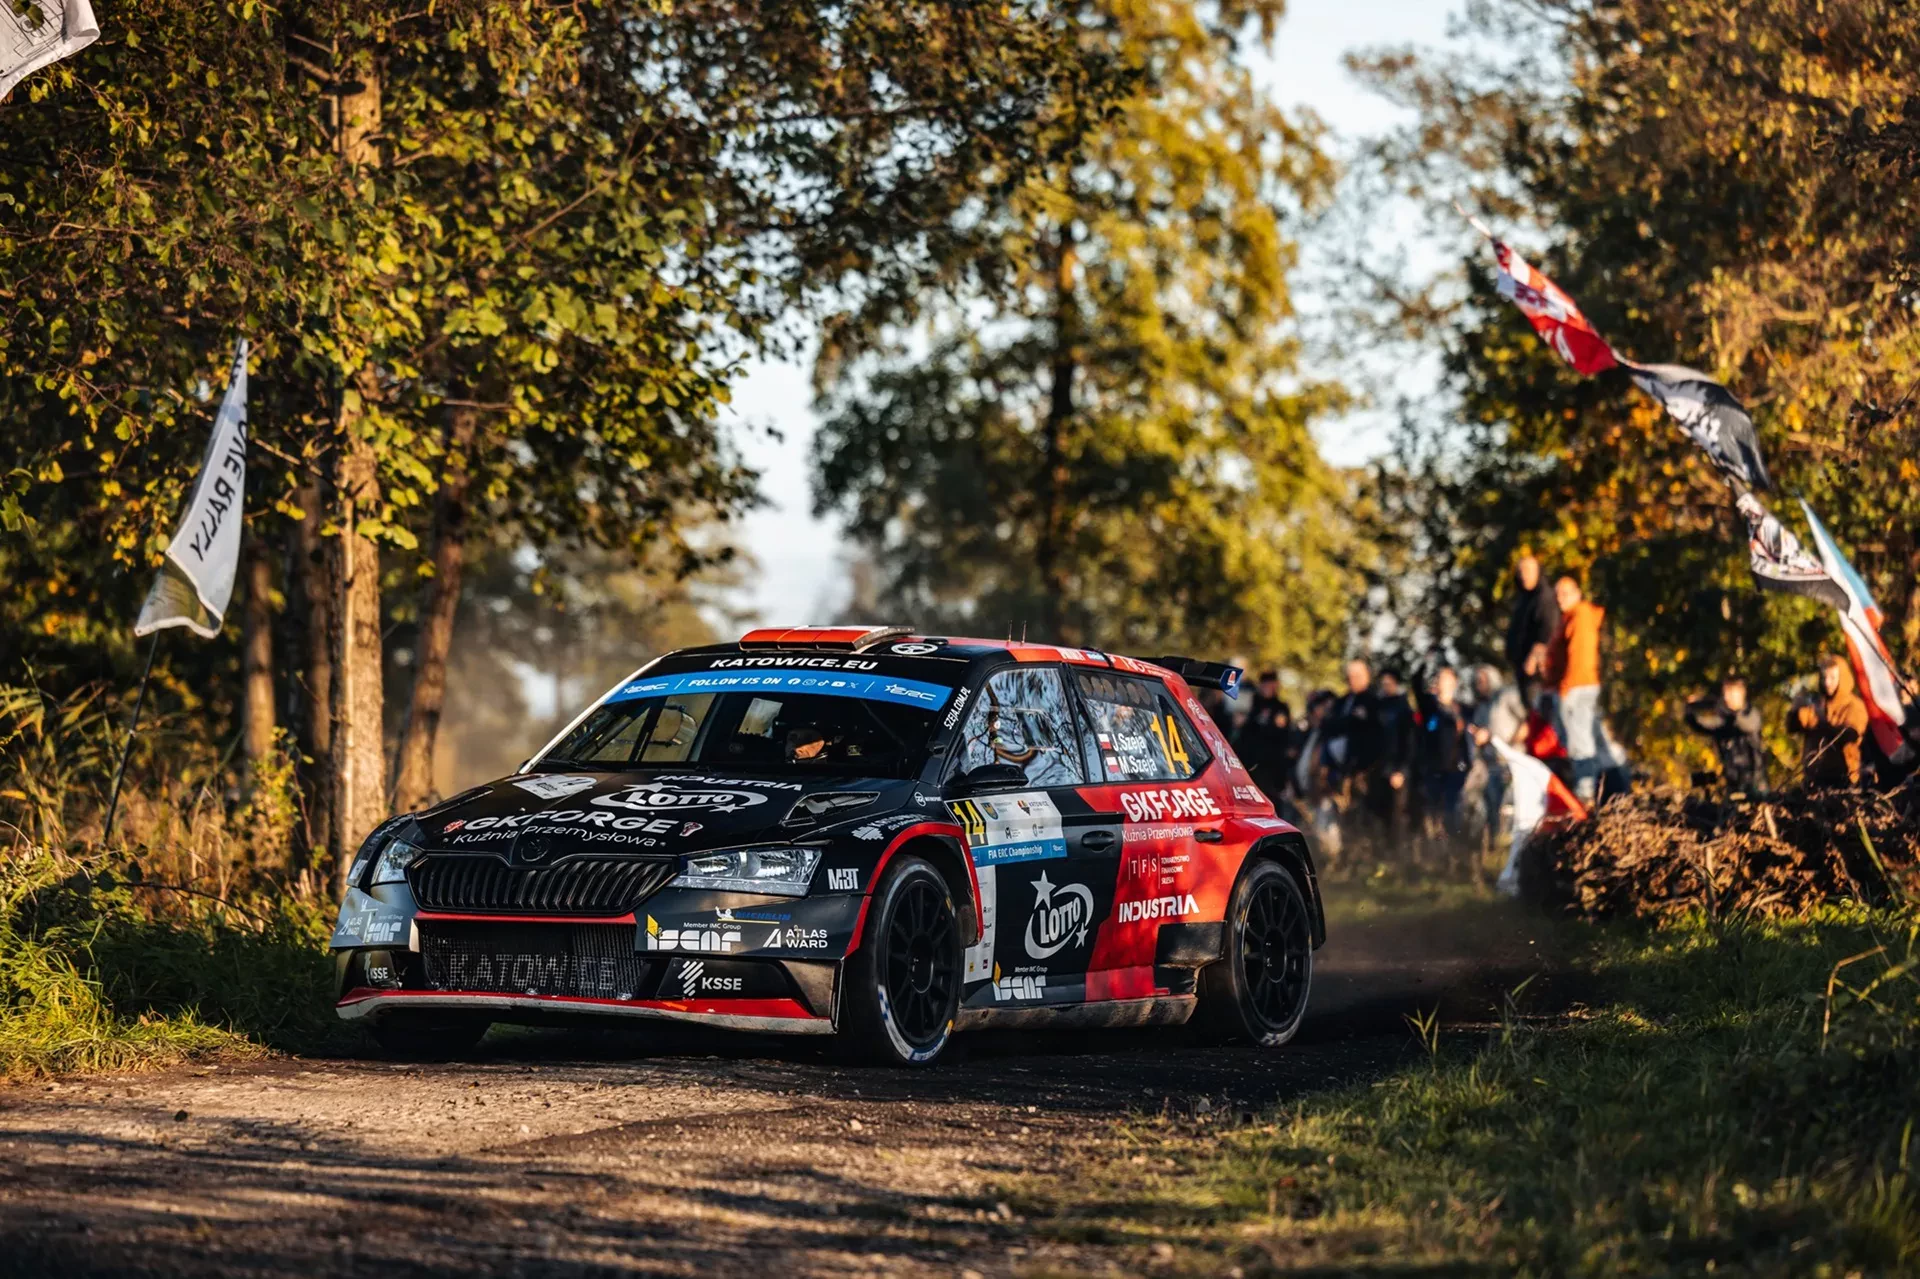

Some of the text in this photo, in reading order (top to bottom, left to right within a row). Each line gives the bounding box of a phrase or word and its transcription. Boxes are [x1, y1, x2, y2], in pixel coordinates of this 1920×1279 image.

[709, 657, 879, 671] KATOWICE.EU
[688, 677, 782, 687] FOLLOW US ON
[1150, 712, 1192, 775] 14
[653, 775, 803, 791] INDUSTRIA
[625, 791, 734, 806] LOTTO
[1120, 787, 1222, 823] GKFORGE
[464, 810, 680, 834] GKFORGE
[953, 800, 985, 846] 14
[452, 824, 657, 848] Kuźnia Przemysłowa
[988, 850, 998, 859] FIA
[998, 848, 1008, 858] ERC
[1009, 844, 1043, 858] Championship
[735, 911, 792, 922] MICHELIN
[1118, 894, 1200, 923] INDUSTRIA
[1039, 896, 1081, 944] LOTTO
[785, 928, 828, 939] ATLAS
[786, 938, 828, 949] WARD
[450, 953, 617, 990] KATOWICE
[702, 977, 742, 991] KSSE
